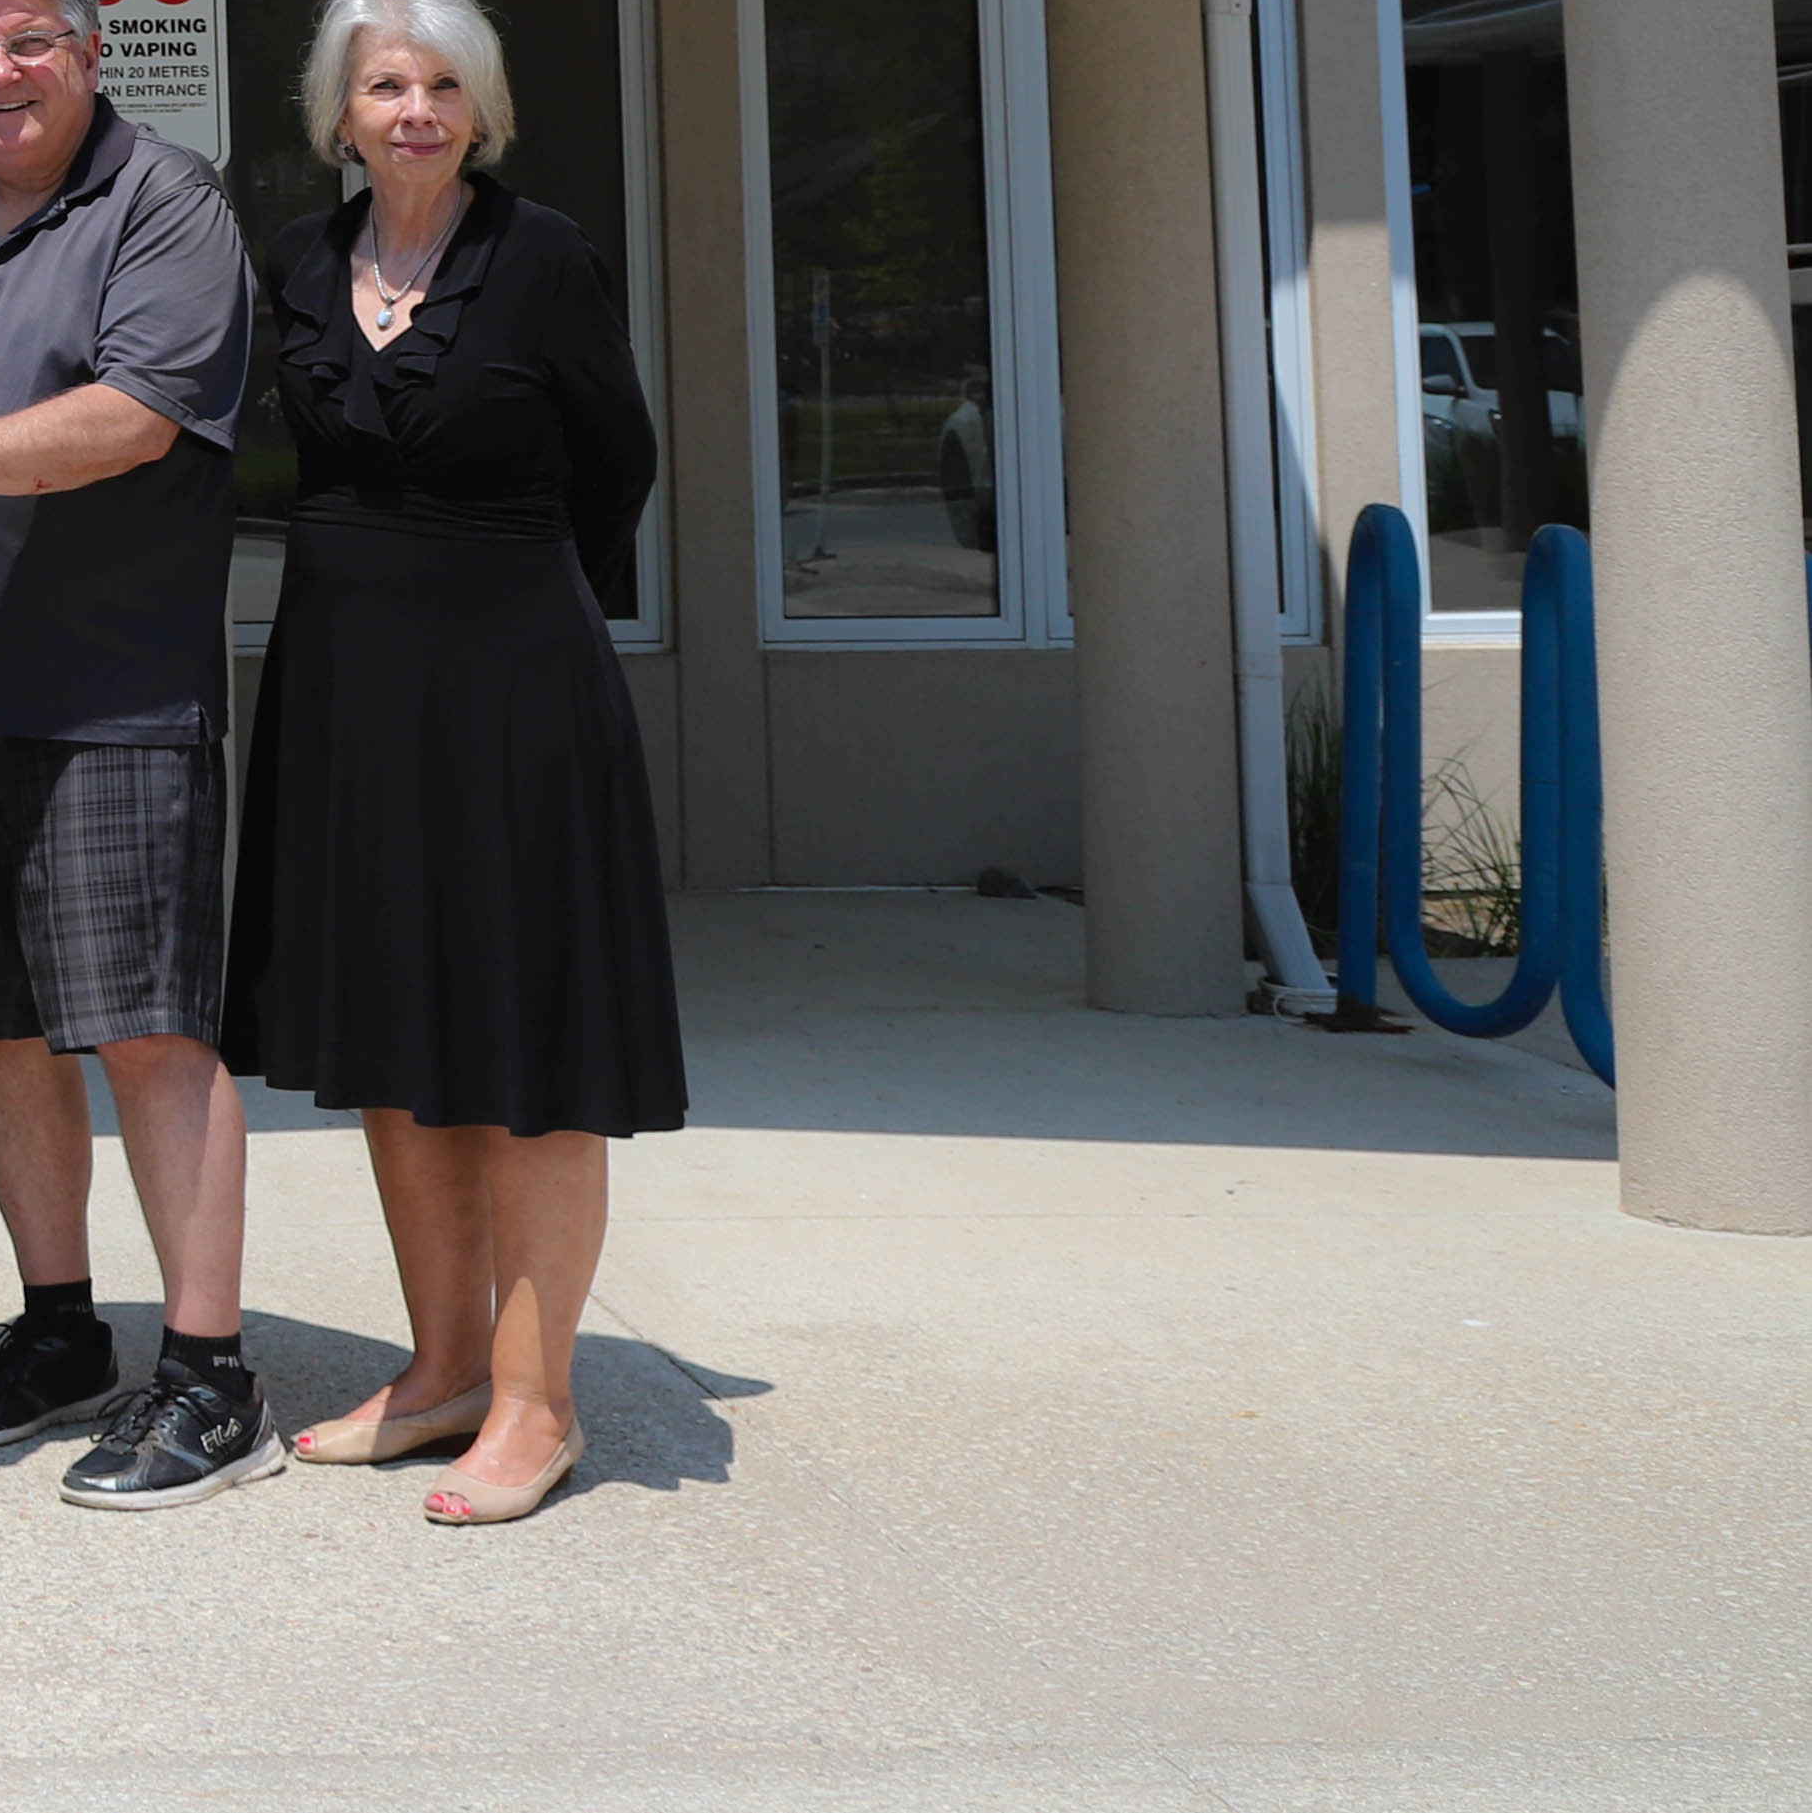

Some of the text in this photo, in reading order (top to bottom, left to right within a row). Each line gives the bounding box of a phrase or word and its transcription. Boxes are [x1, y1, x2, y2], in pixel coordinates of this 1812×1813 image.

[109, 18, 206, 34] SMOKING
[100, 41, 197, 58] O VAPING
[129, 66, 144, 78] 20
[149, 65, 209, 78] METRES
[126, 84, 207, 97] ENTRANCE
